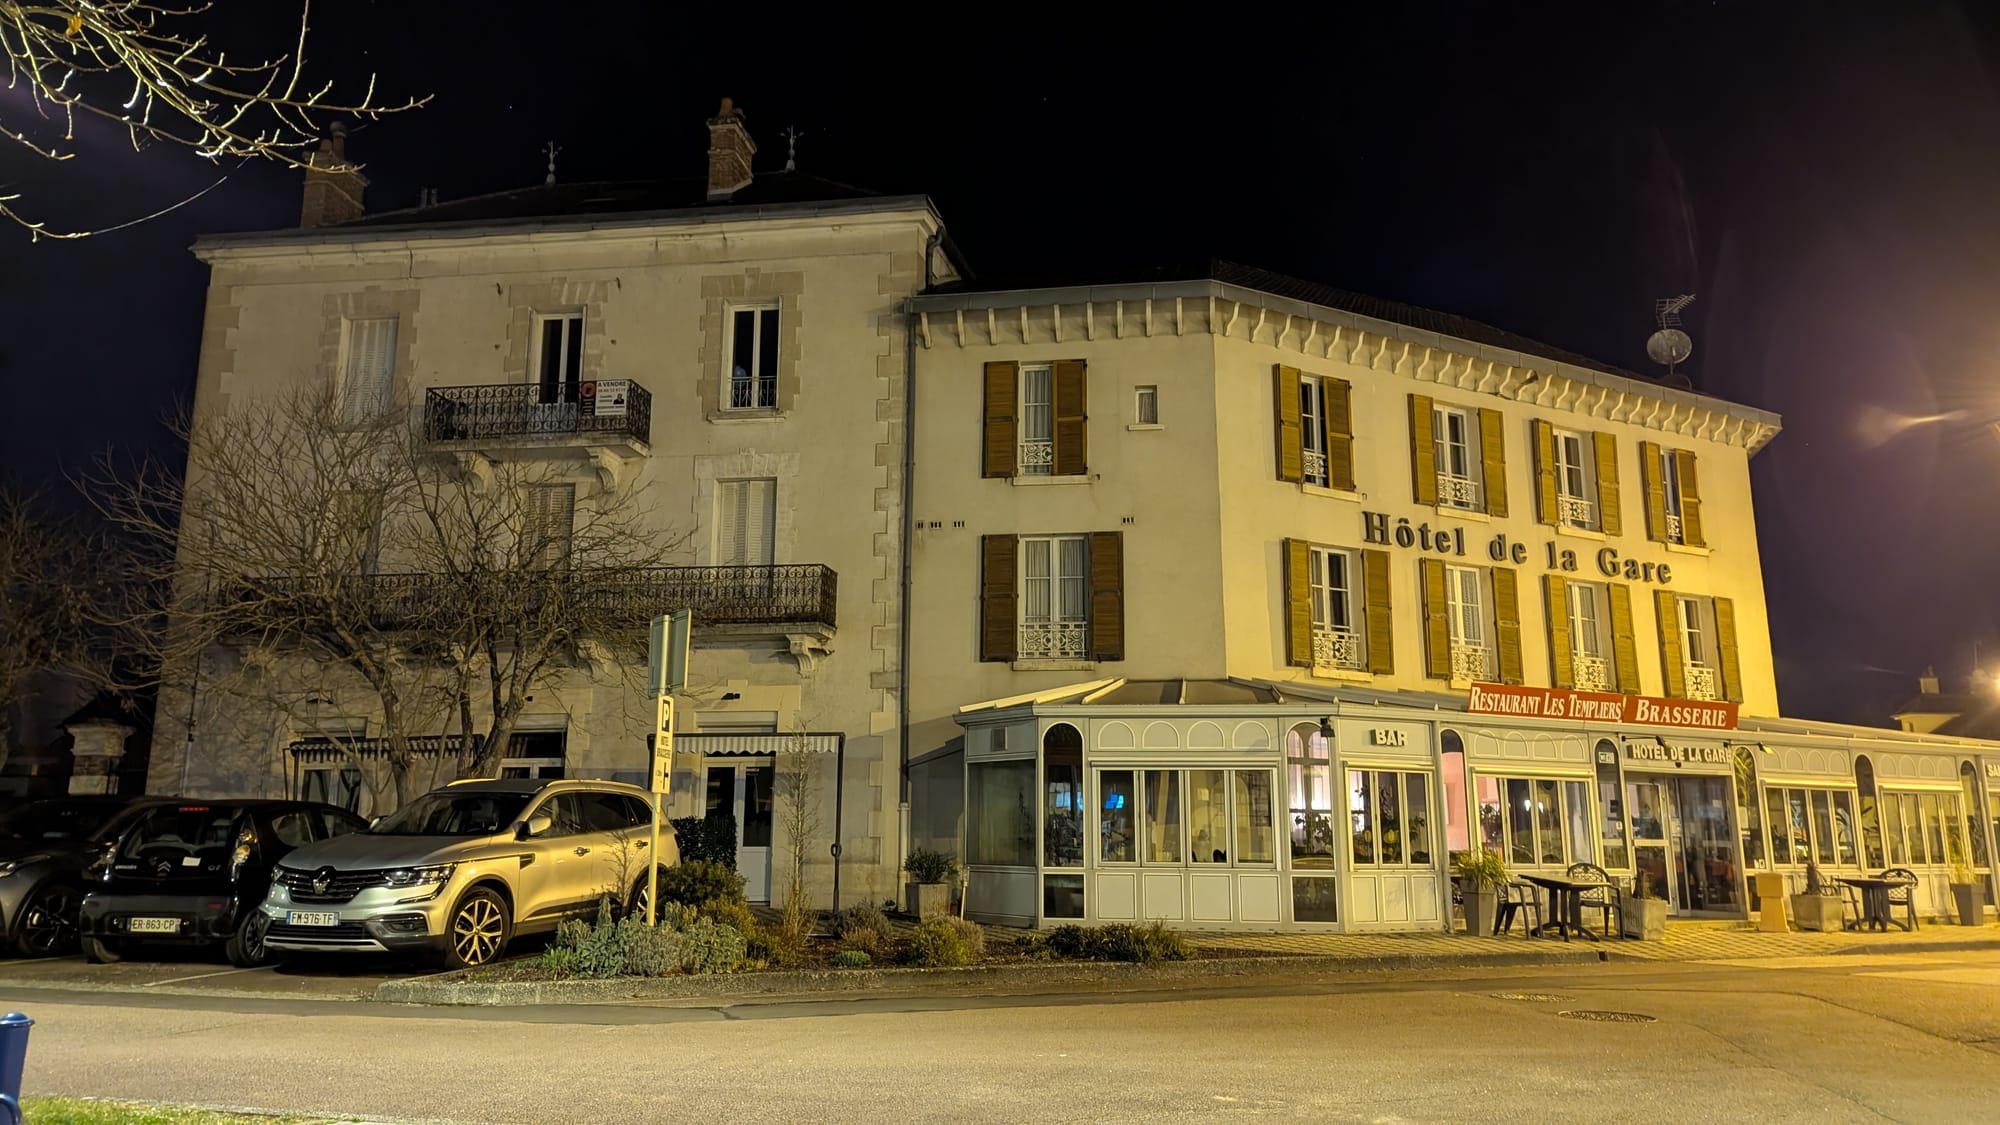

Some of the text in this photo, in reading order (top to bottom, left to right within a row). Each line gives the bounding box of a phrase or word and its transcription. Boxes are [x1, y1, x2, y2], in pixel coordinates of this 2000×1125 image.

[1362, 511, 1673, 584] Hôtel de la Gare
[1469, 686, 1622, 720] RESTAURANT LES TEMPLIERS
[1635, 699, 1727, 727] BRASSERIE
[1374, 728, 1408, 747] BAR
[1632, 744, 1731, 763] HOTEL DE LA GARE
